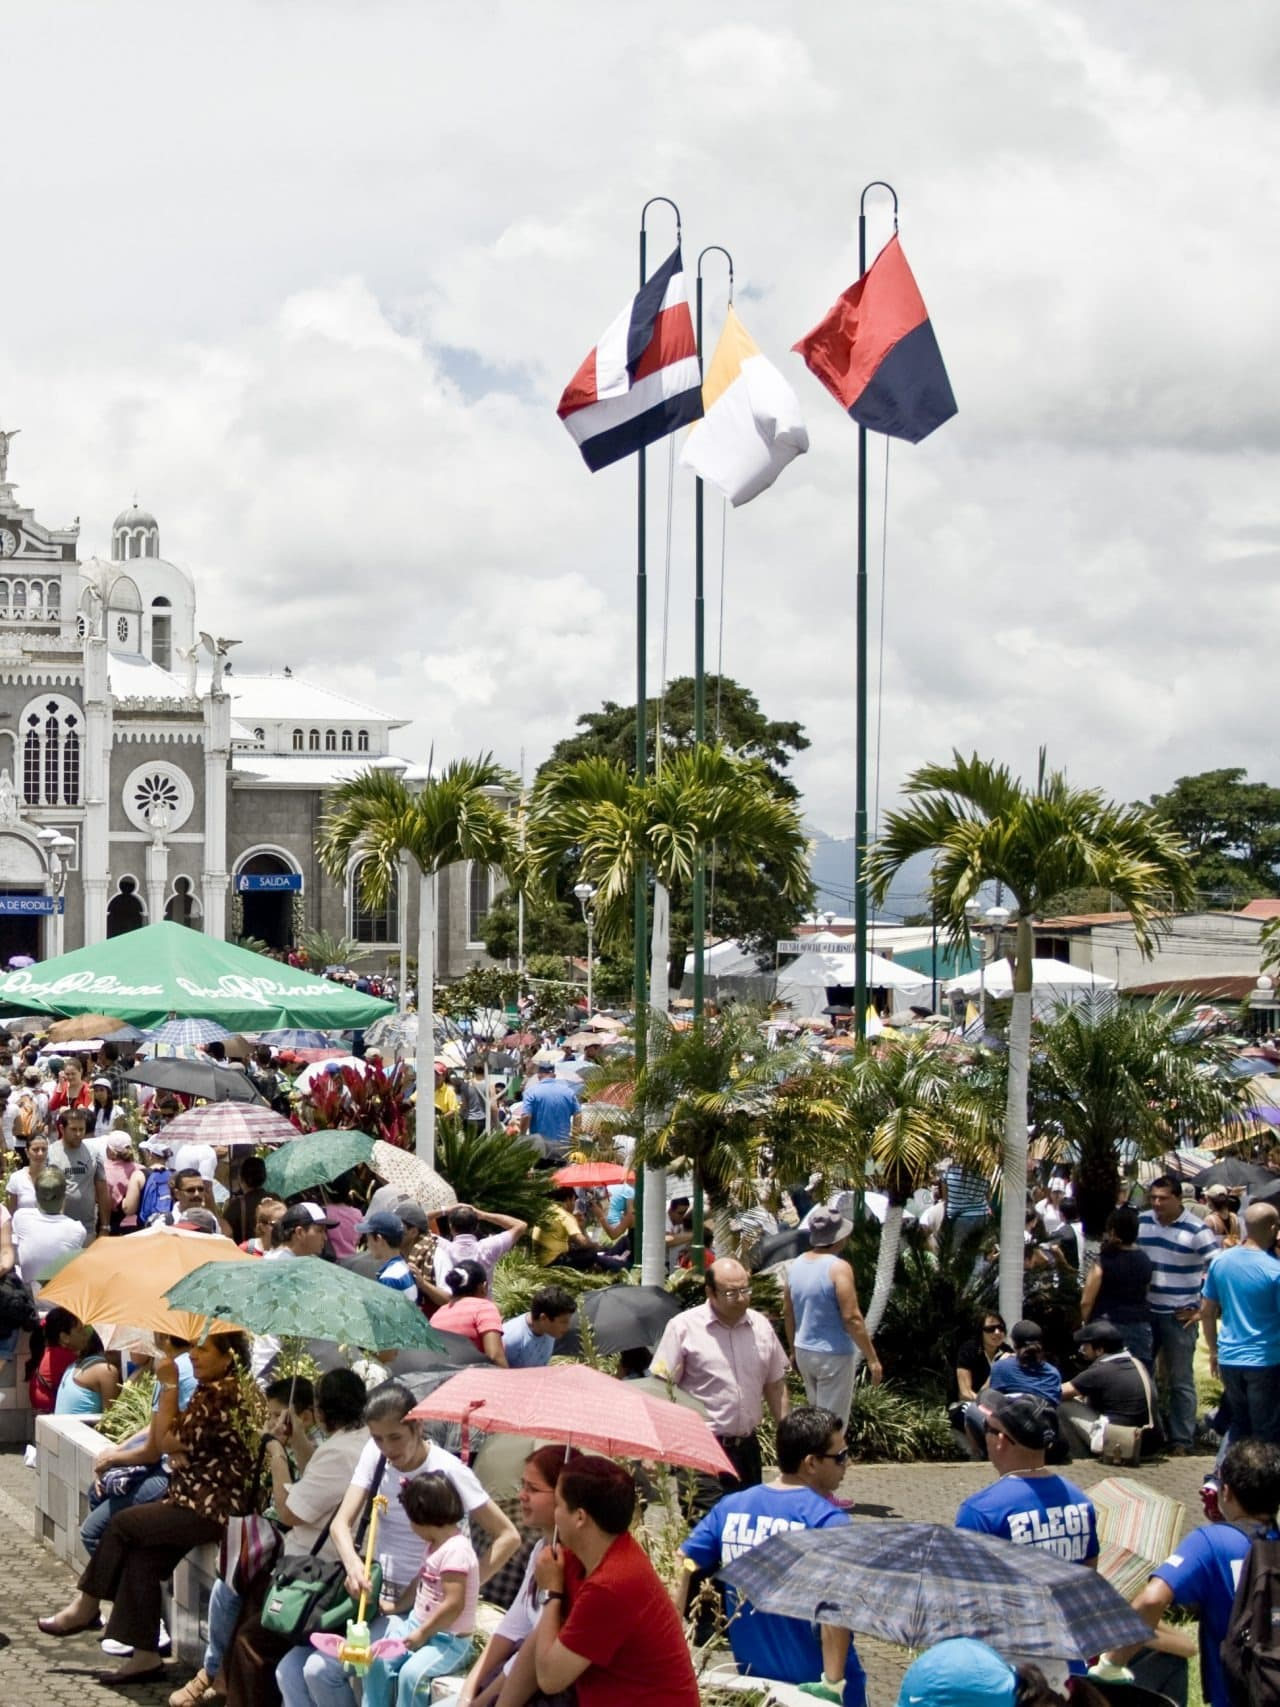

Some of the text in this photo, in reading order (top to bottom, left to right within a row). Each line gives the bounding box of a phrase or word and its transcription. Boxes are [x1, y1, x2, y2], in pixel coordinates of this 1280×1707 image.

[259, 877, 290, 887] SALIDA
[7, 900, 20, 910] DE
[64, 1167, 86, 1175] PUMA
